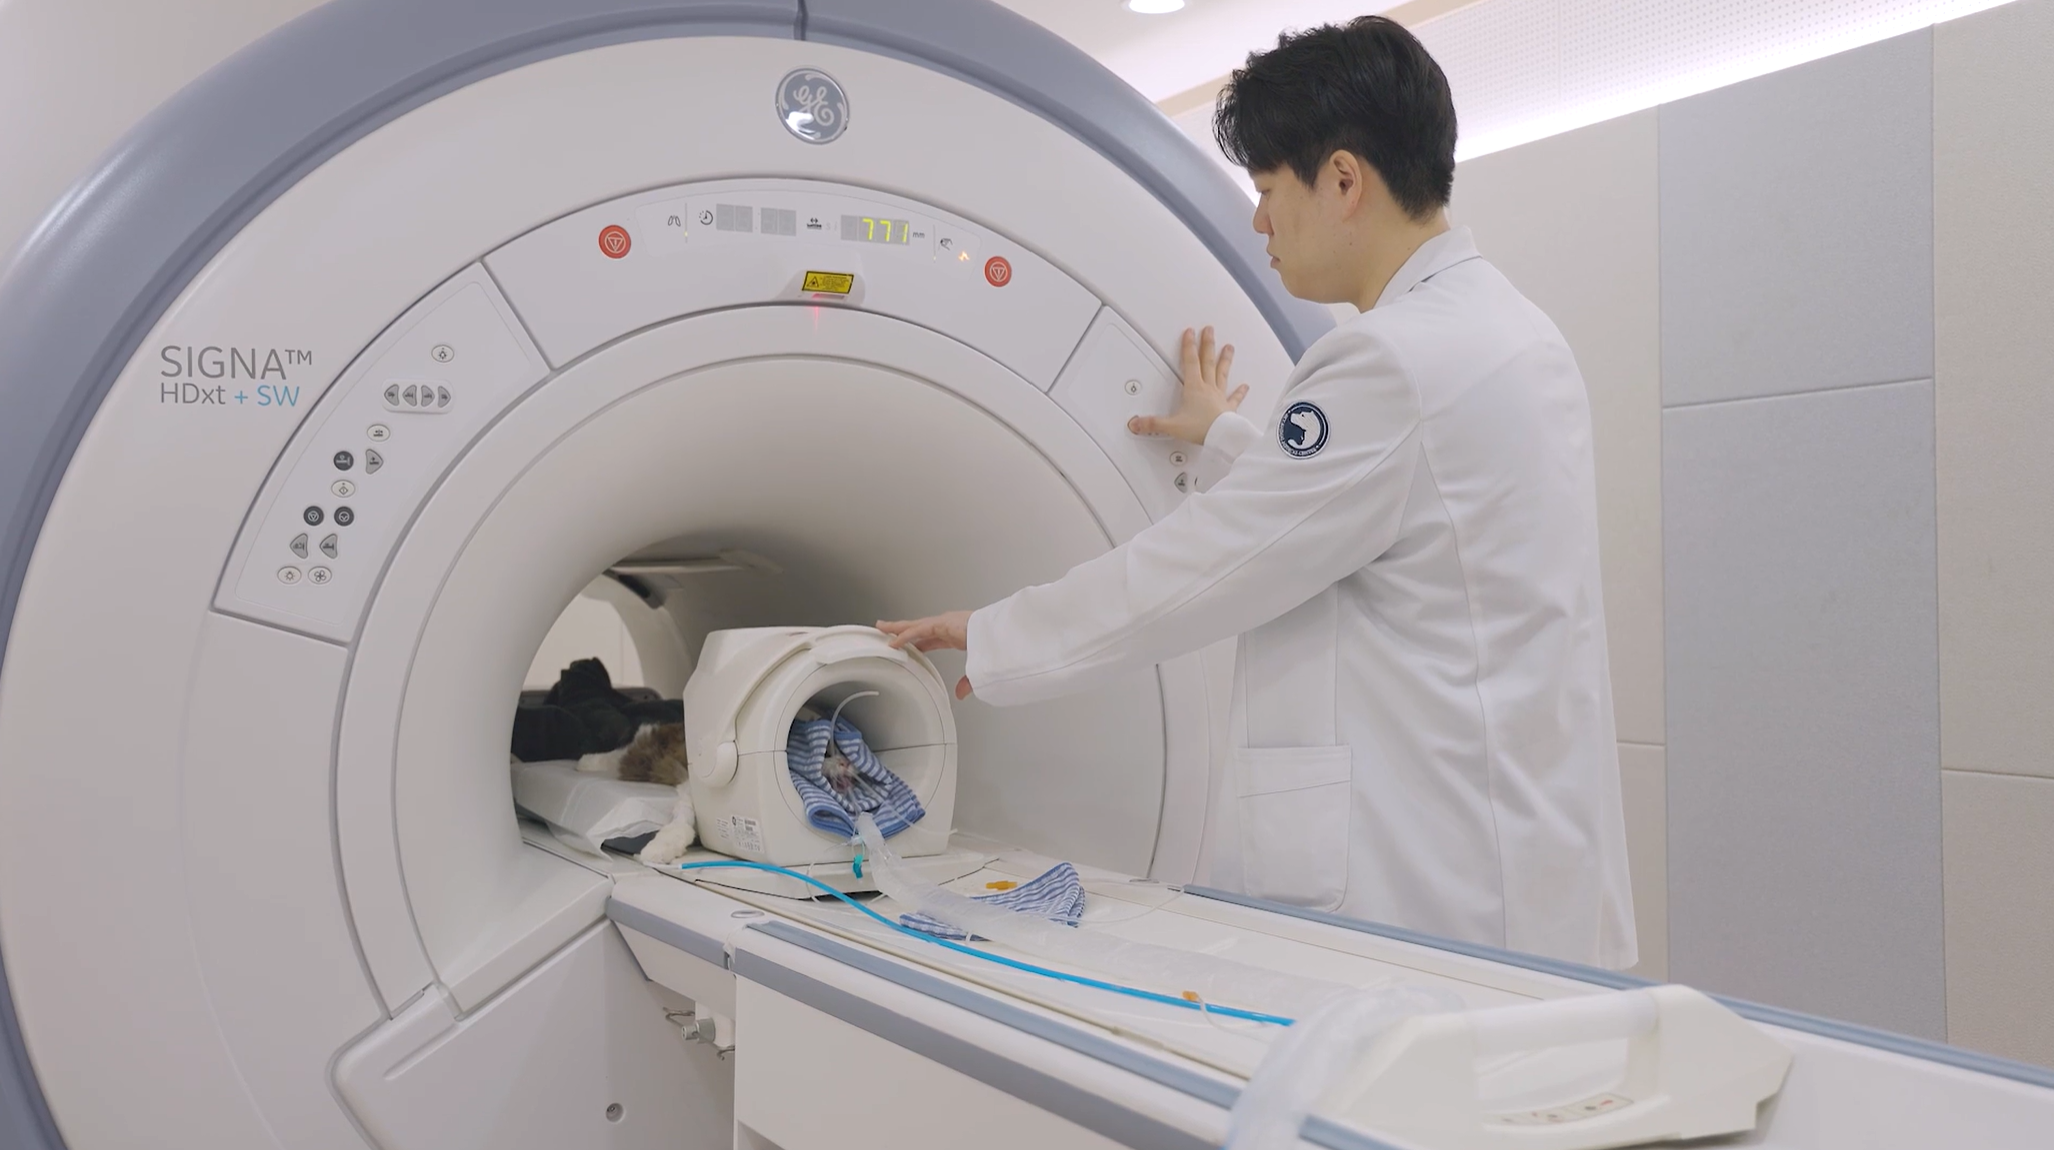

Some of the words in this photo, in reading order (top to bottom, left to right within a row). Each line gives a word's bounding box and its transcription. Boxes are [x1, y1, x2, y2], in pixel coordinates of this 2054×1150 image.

[862, 218, 909, 243] 771
[912, 231, 926, 239] mm
[160, 382, 226, 405] HDxt
[234, 390, 248, 404] +
[257, 384, 300, 407] SW
